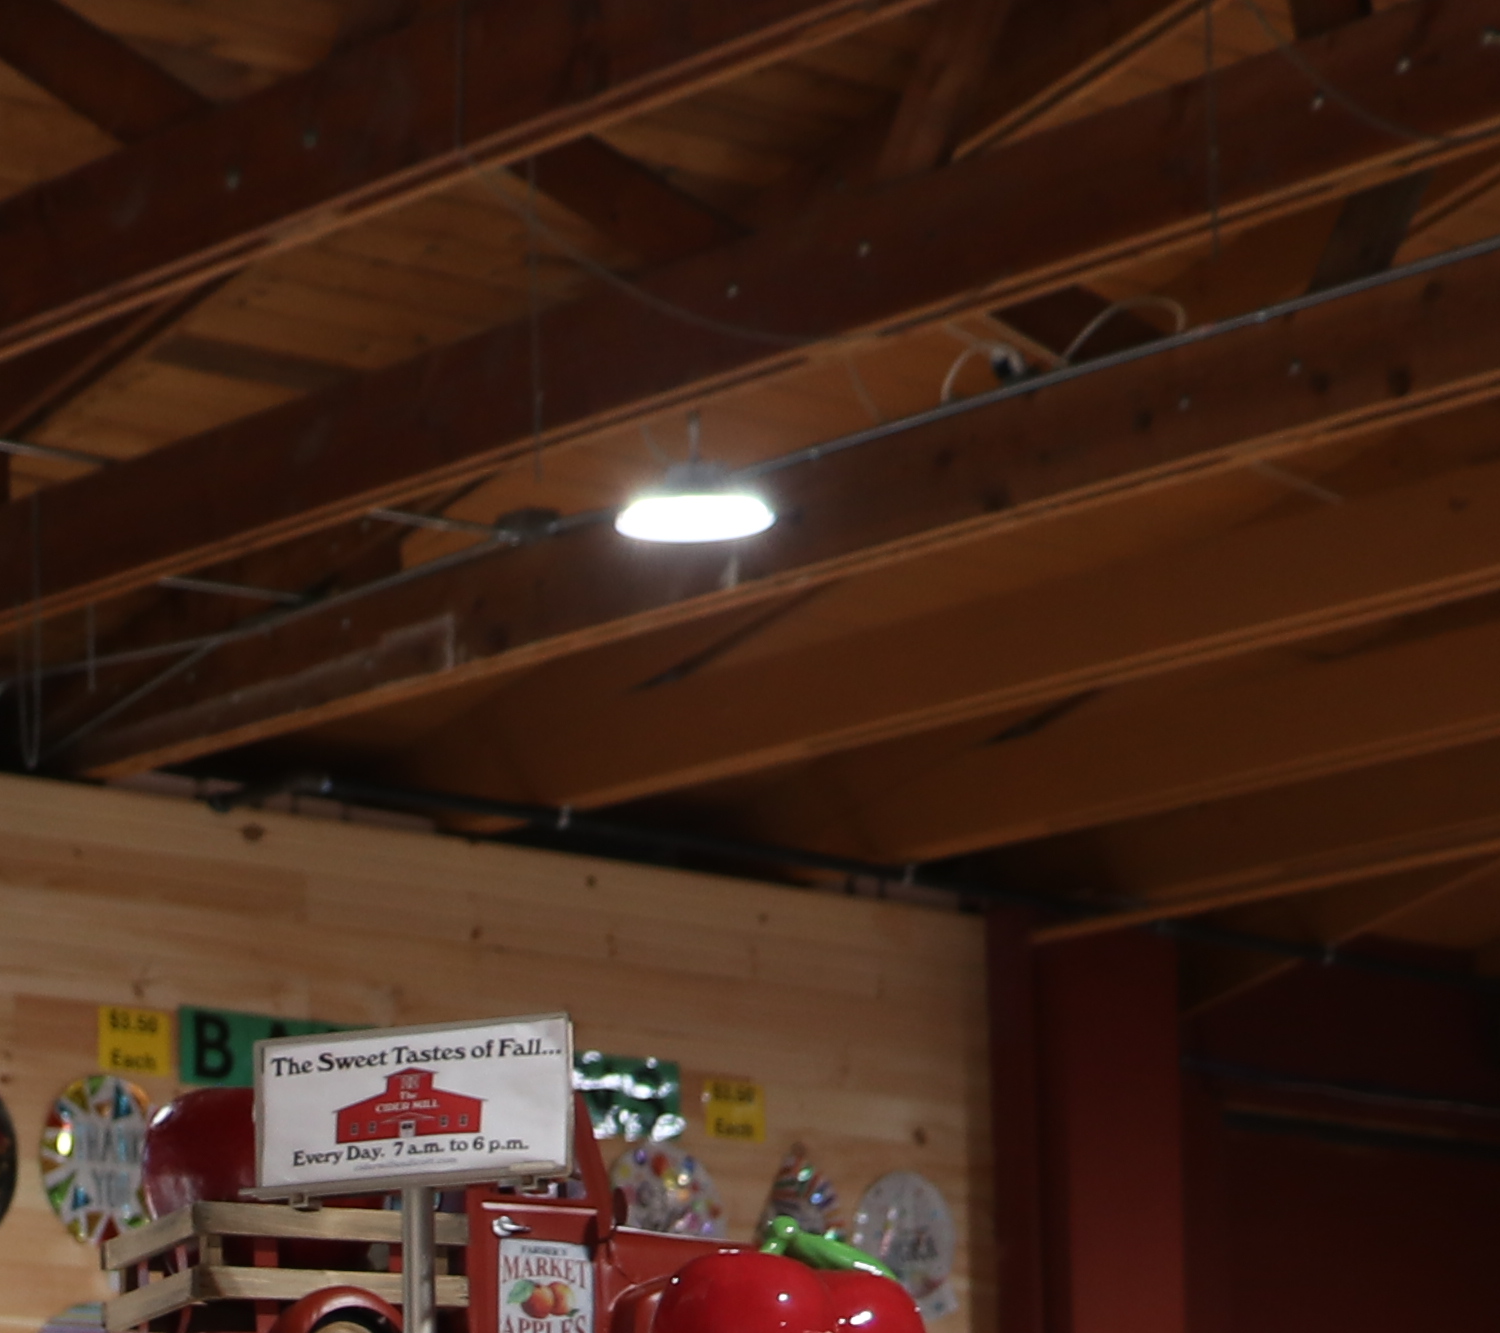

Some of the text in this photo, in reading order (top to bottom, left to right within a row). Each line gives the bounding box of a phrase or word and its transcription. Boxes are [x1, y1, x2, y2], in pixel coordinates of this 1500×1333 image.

[112, 1049, 156, 1072] Each
[270, 1037, 562, 1078] The Sweet Tastes of Fall...
[374, 1099, 441, 1113] CIDER MILL
[292, 1136, 530, 1168] Every Day. 7 a.m. to 6 p.m.
[501, 1254, 588, 1290] MARKET
